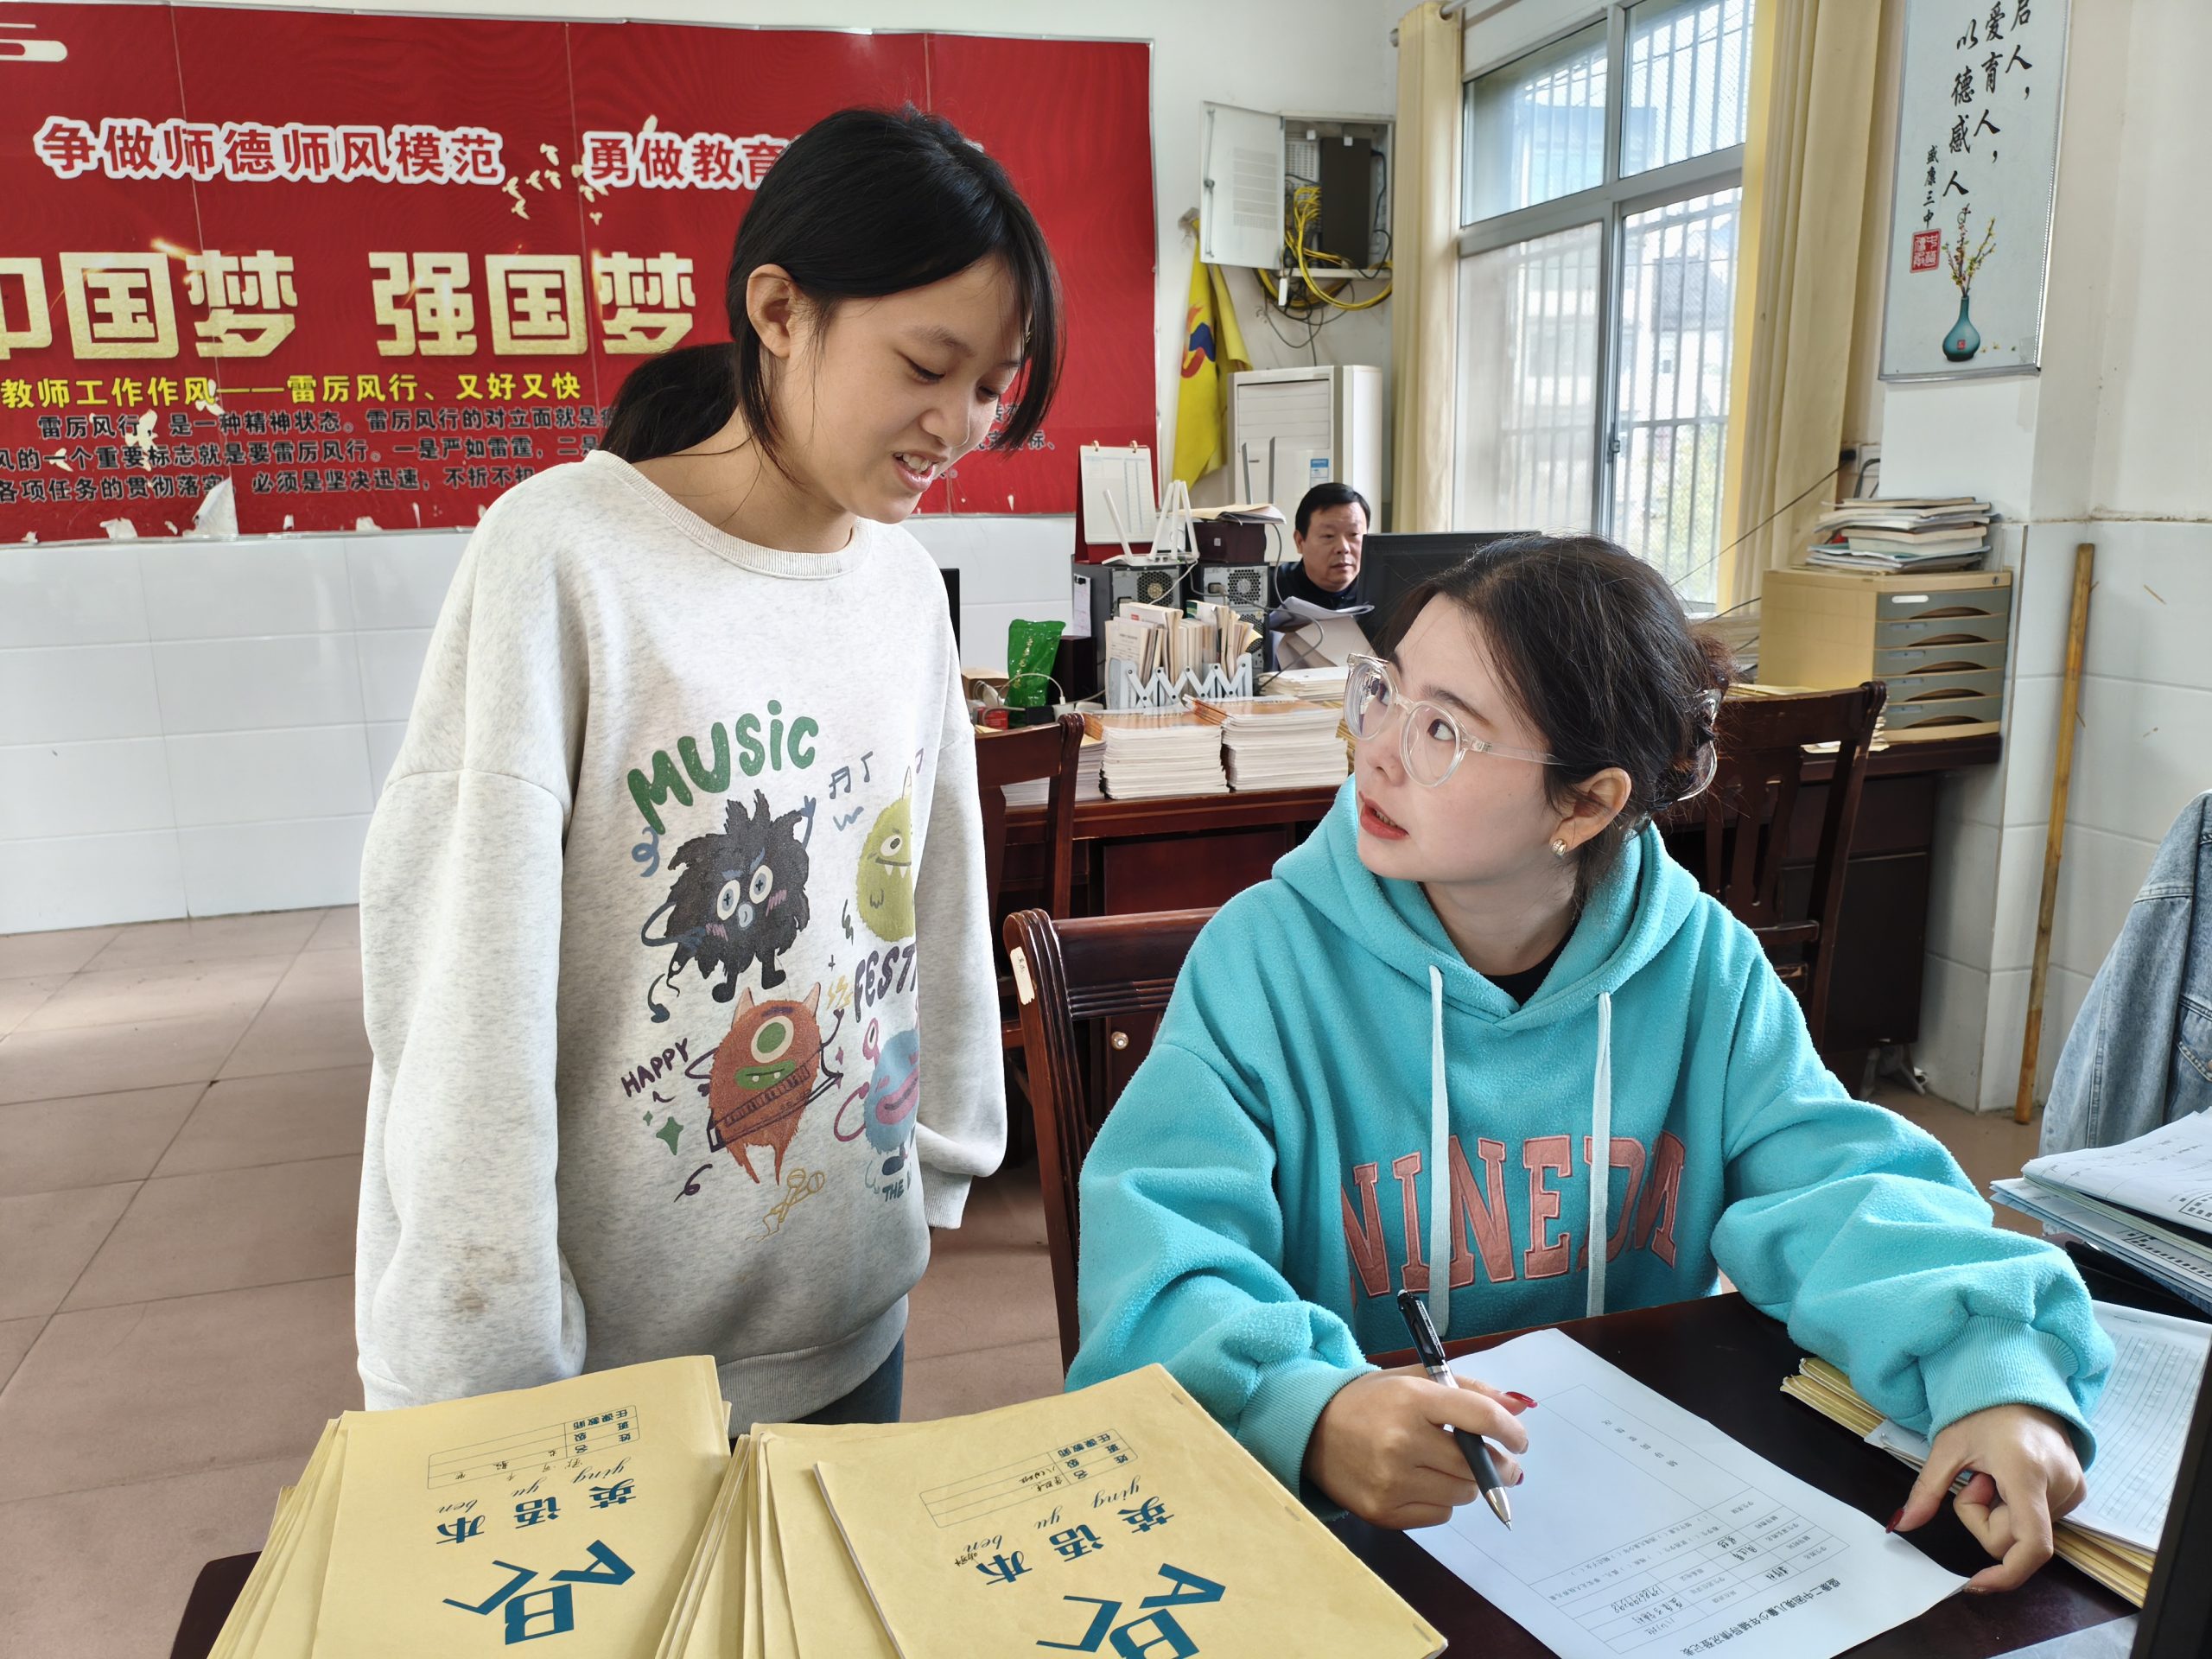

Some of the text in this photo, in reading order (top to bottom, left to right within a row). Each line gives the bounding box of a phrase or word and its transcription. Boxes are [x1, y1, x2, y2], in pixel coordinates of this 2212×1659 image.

[1942, 18, 1979, 197] 以德感人
[35, 117, 505, 184] 争做师德师风模范
[368, 251, 696, 357] 强国梦
[853, 941, 917, 1023] FEST
[620, 1037, 690, 1097] HAPPY
[882, 1179, 905, 1202] THE
[573, 1408, 628, 1431] 任课教师
[1057, 1433, 1111, 1459] 任课教师
[512, 1477, 548, 1497] yu
[573, 1456, 632, 1484] ying
[1091, 1475, 1141, 1510] ying
[436, 1499, 478, 1514] ben
[436, 1478, 637, 1545] 英语本
[1034, 1505, 1064, 1530] yu
[963, 1534, 1003, 1554] ben
[975, 1496, 1175, 1586] 英语本
[442, 1539, 636, 1645] ABC
[1036, 1562, 1226, 1659] ABC
